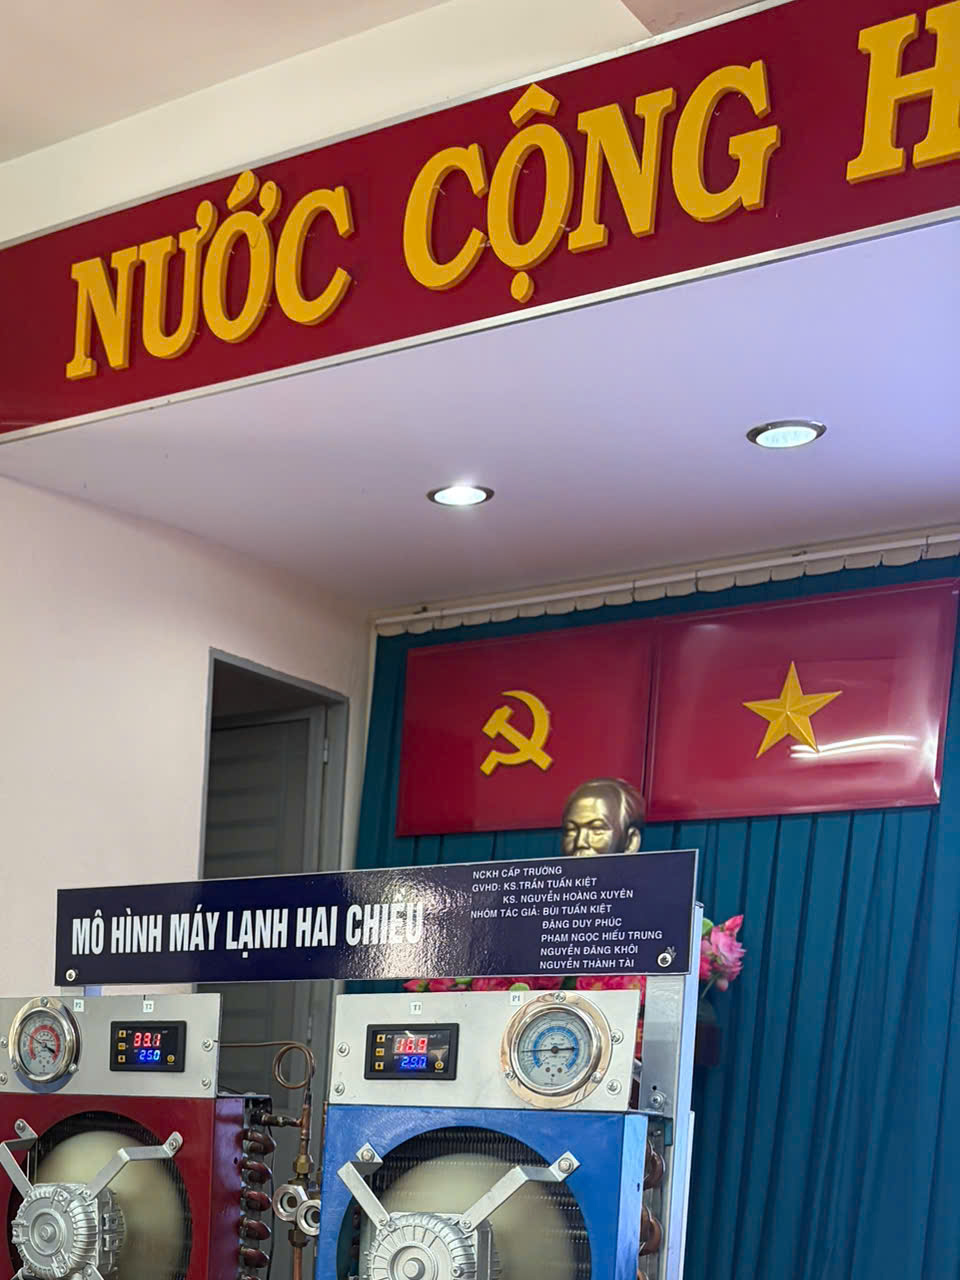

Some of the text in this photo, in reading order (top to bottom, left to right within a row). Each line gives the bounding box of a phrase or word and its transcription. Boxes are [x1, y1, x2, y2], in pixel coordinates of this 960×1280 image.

[65, 168, 355, 380] NƯỚC
[403, 83, 780, 303] CỘNG
[472, 865, 563, 880] NCKH CẤP TRƯỜNG
[471, 882, 501, 893] GVHD:
[546, 876, 572, 889] TUẤN
[574, 876, 597, 888] KIỆT
[502, 894, 518, 905] KS.
[562, 888, 597, 901] HOÀNG
[600, 888, 634, 900] XUYÊN
[470, 906, 498, 919] NHÓM
[499, 905, 519, 918] TÁC
[520, 903, 540, 917] GIẢ:
[561, 903, 588, 915] TUẤN
[589, 902, 613, 914] KIỆT
[572, 918, 593, 929] DUY
[595, 915, 622, 928] PHÚC
[71, 909, 104, 955] MÔ
[110, 907, 163, 954] HÌNH
[169, 903, 220, 952] MÁY
[225, 908, 288, 959] LẠNH
[295, 905, 339, 948] HAI
[540, 933, 569, 944] PHẠM
[570, 932, 600, 944] NGỌC
[628, 930, 663, 941] TRUNG
[614, 943, 639, 955] KHÔI
[582, 956, 616, 969] THÀNH
[618, 956, 635, 968] TÀI
